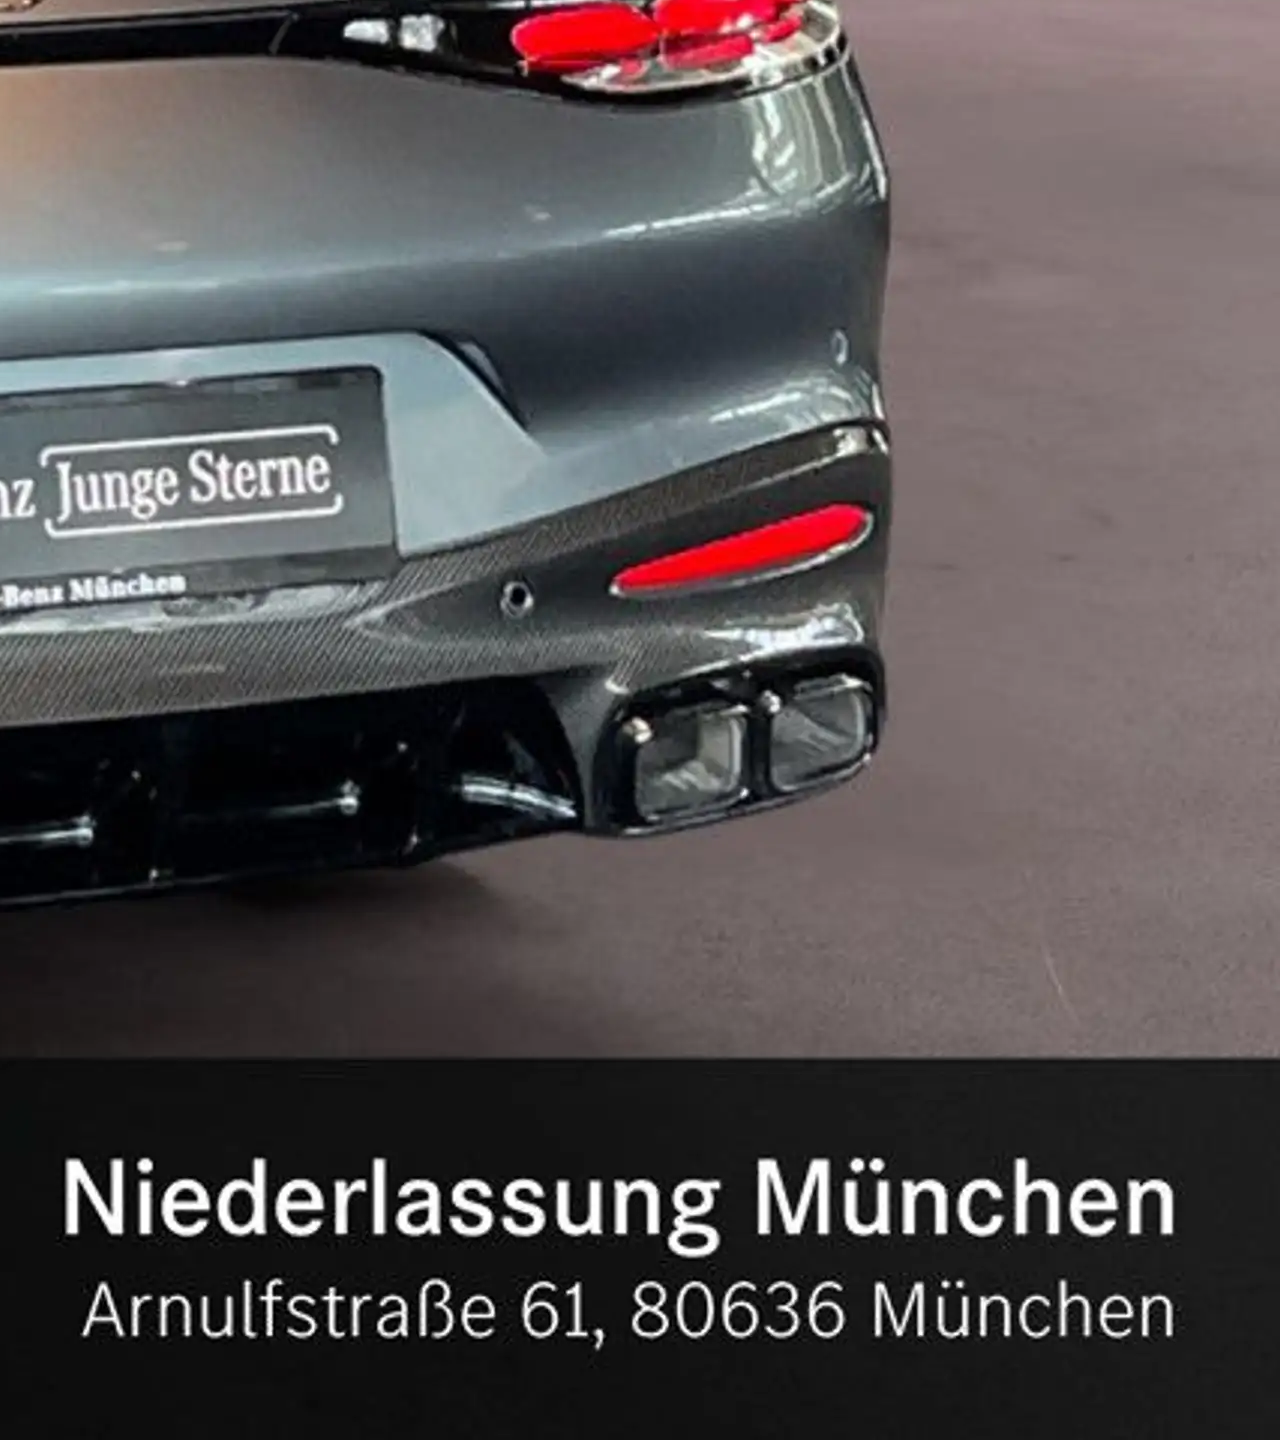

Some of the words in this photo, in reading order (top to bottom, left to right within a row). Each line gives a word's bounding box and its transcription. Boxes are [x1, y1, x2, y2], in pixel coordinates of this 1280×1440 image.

[55, 461, 180, 521] Junge
[188, 448, 332, 503] Sterne
[69, 568, 188, 603] München
